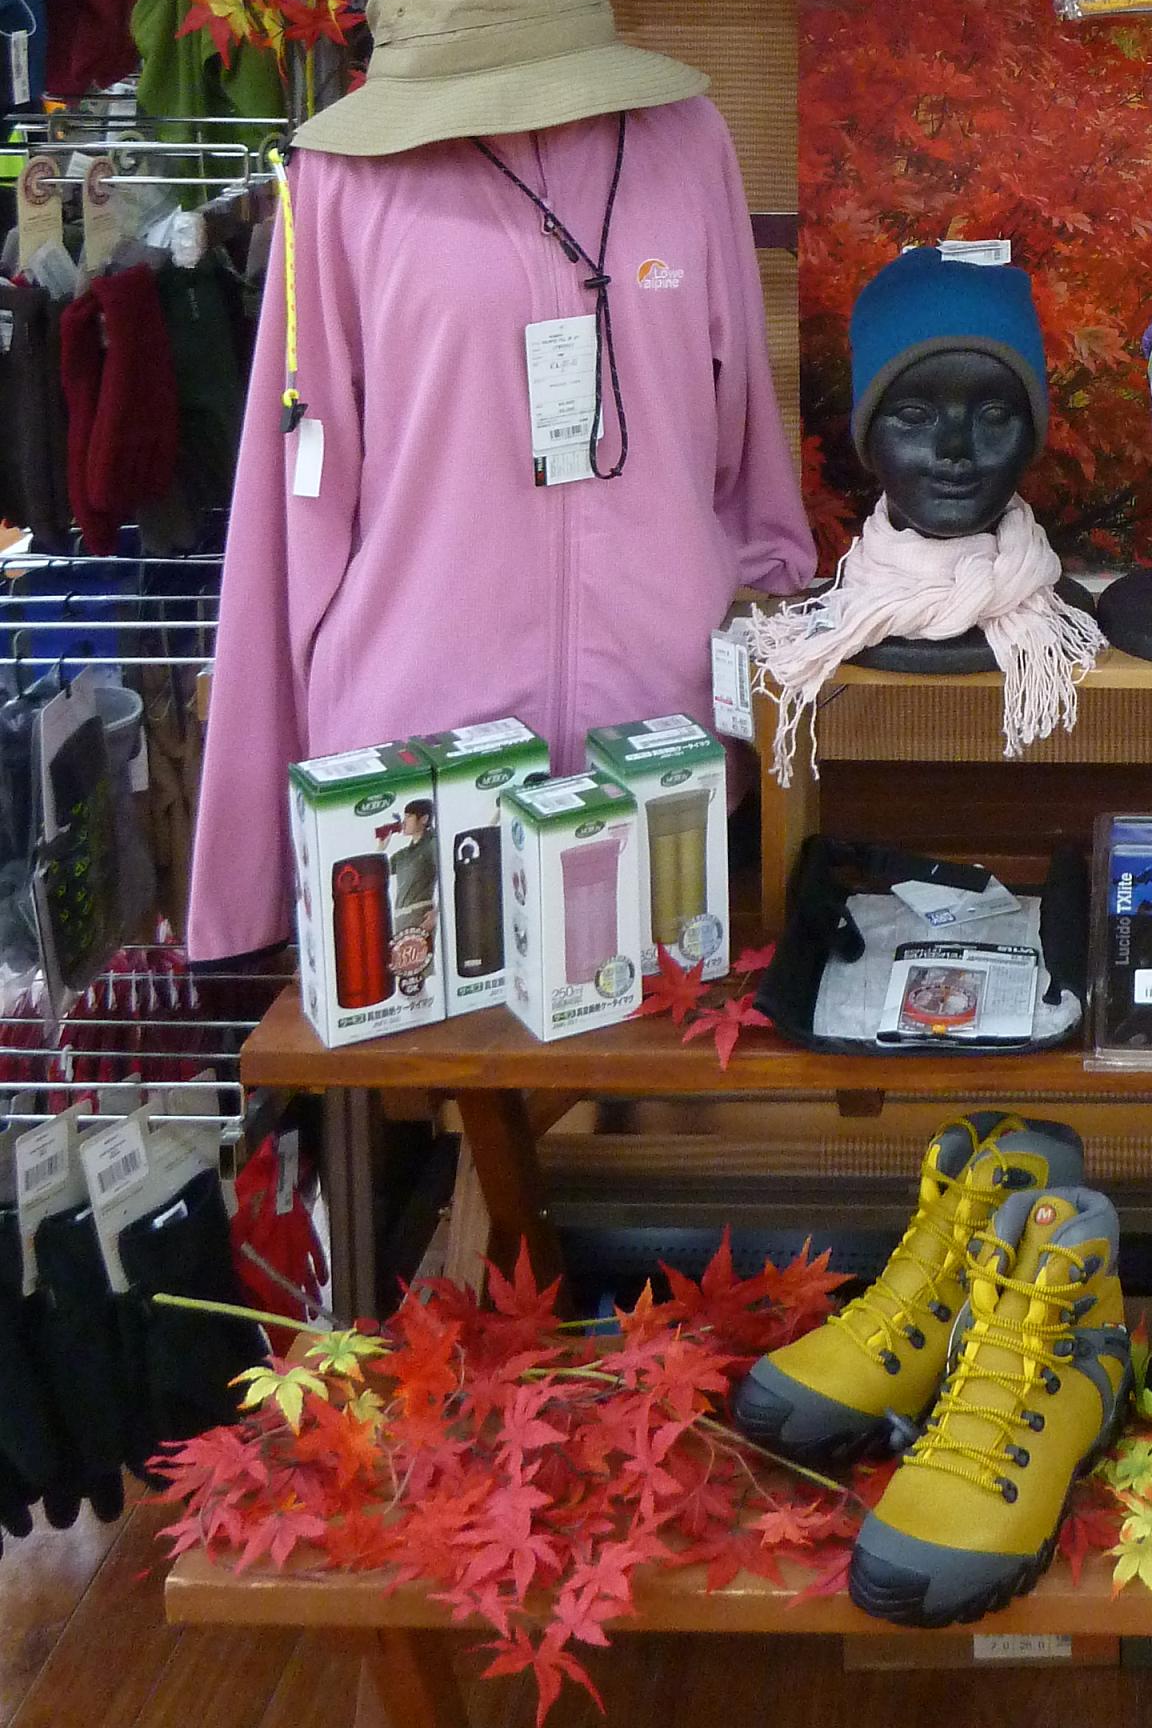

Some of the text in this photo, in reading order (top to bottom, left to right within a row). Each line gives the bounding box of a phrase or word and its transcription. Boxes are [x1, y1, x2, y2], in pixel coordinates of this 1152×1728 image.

[654, 266, 684, 279] Lowe
[640, 277, 681, 291] alpine
[1116, 872, 1133, 913] TXlite
[1115, 916, 1131, 966] Lucido
[997, 945, 1035, 954] SILVA
